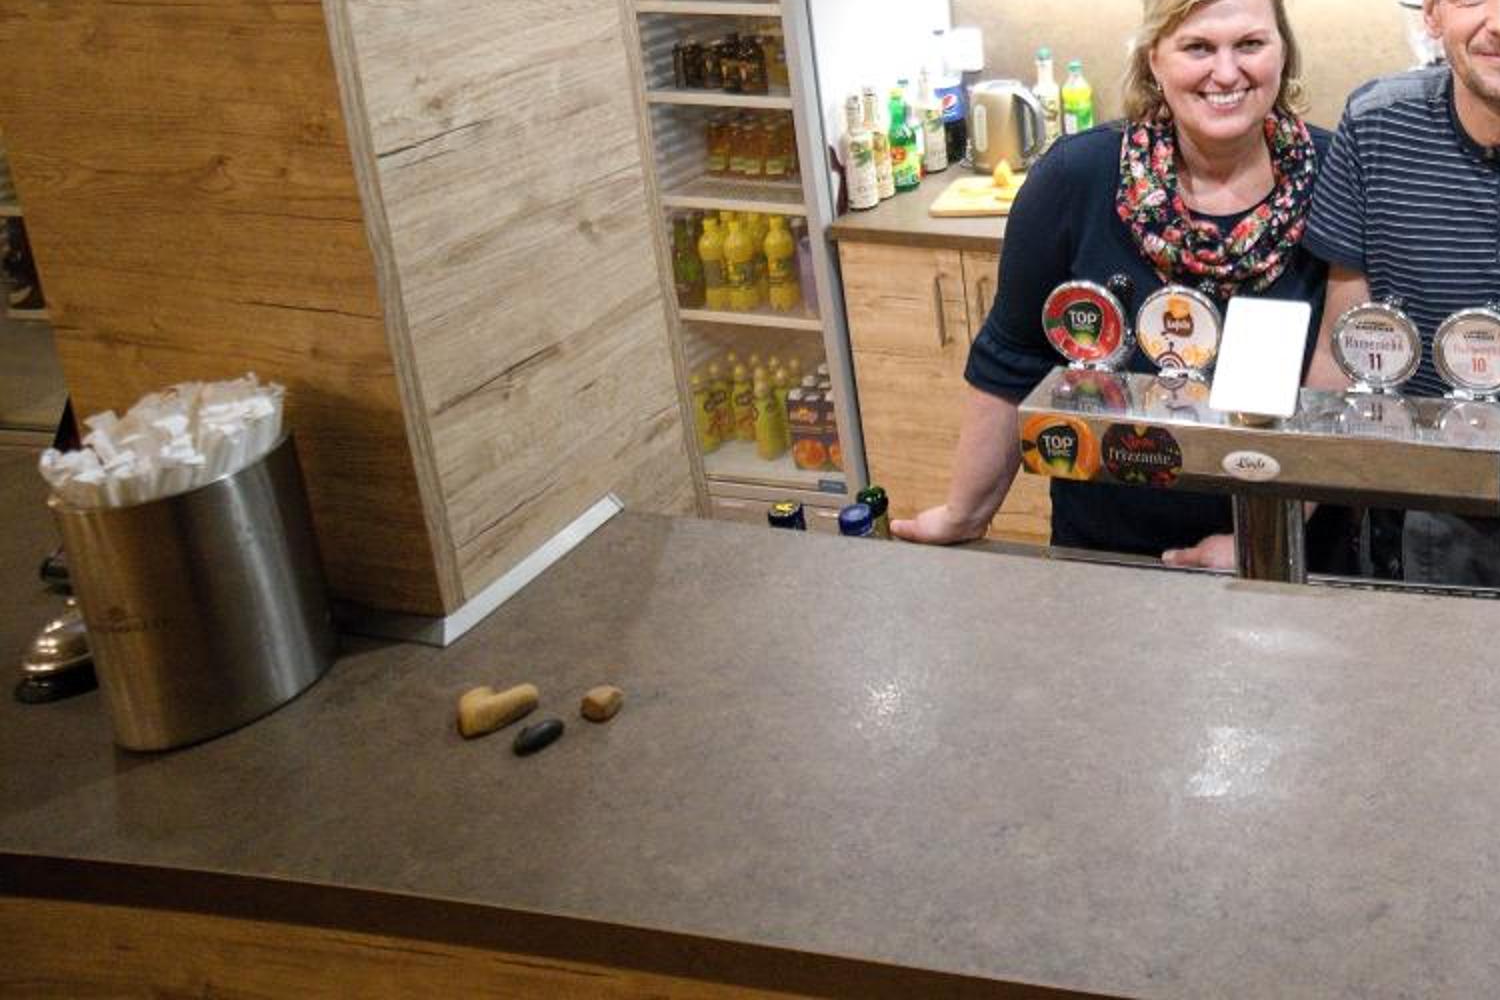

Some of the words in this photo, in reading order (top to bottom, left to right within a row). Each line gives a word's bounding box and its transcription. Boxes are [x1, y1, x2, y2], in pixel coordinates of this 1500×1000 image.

[1067, 310, 1098, 325] TOP
[1367, 353, 1382, 371] 11
[1471, 357, 1487, 373] 10
[1041, 434, 1074, 448] TOP
